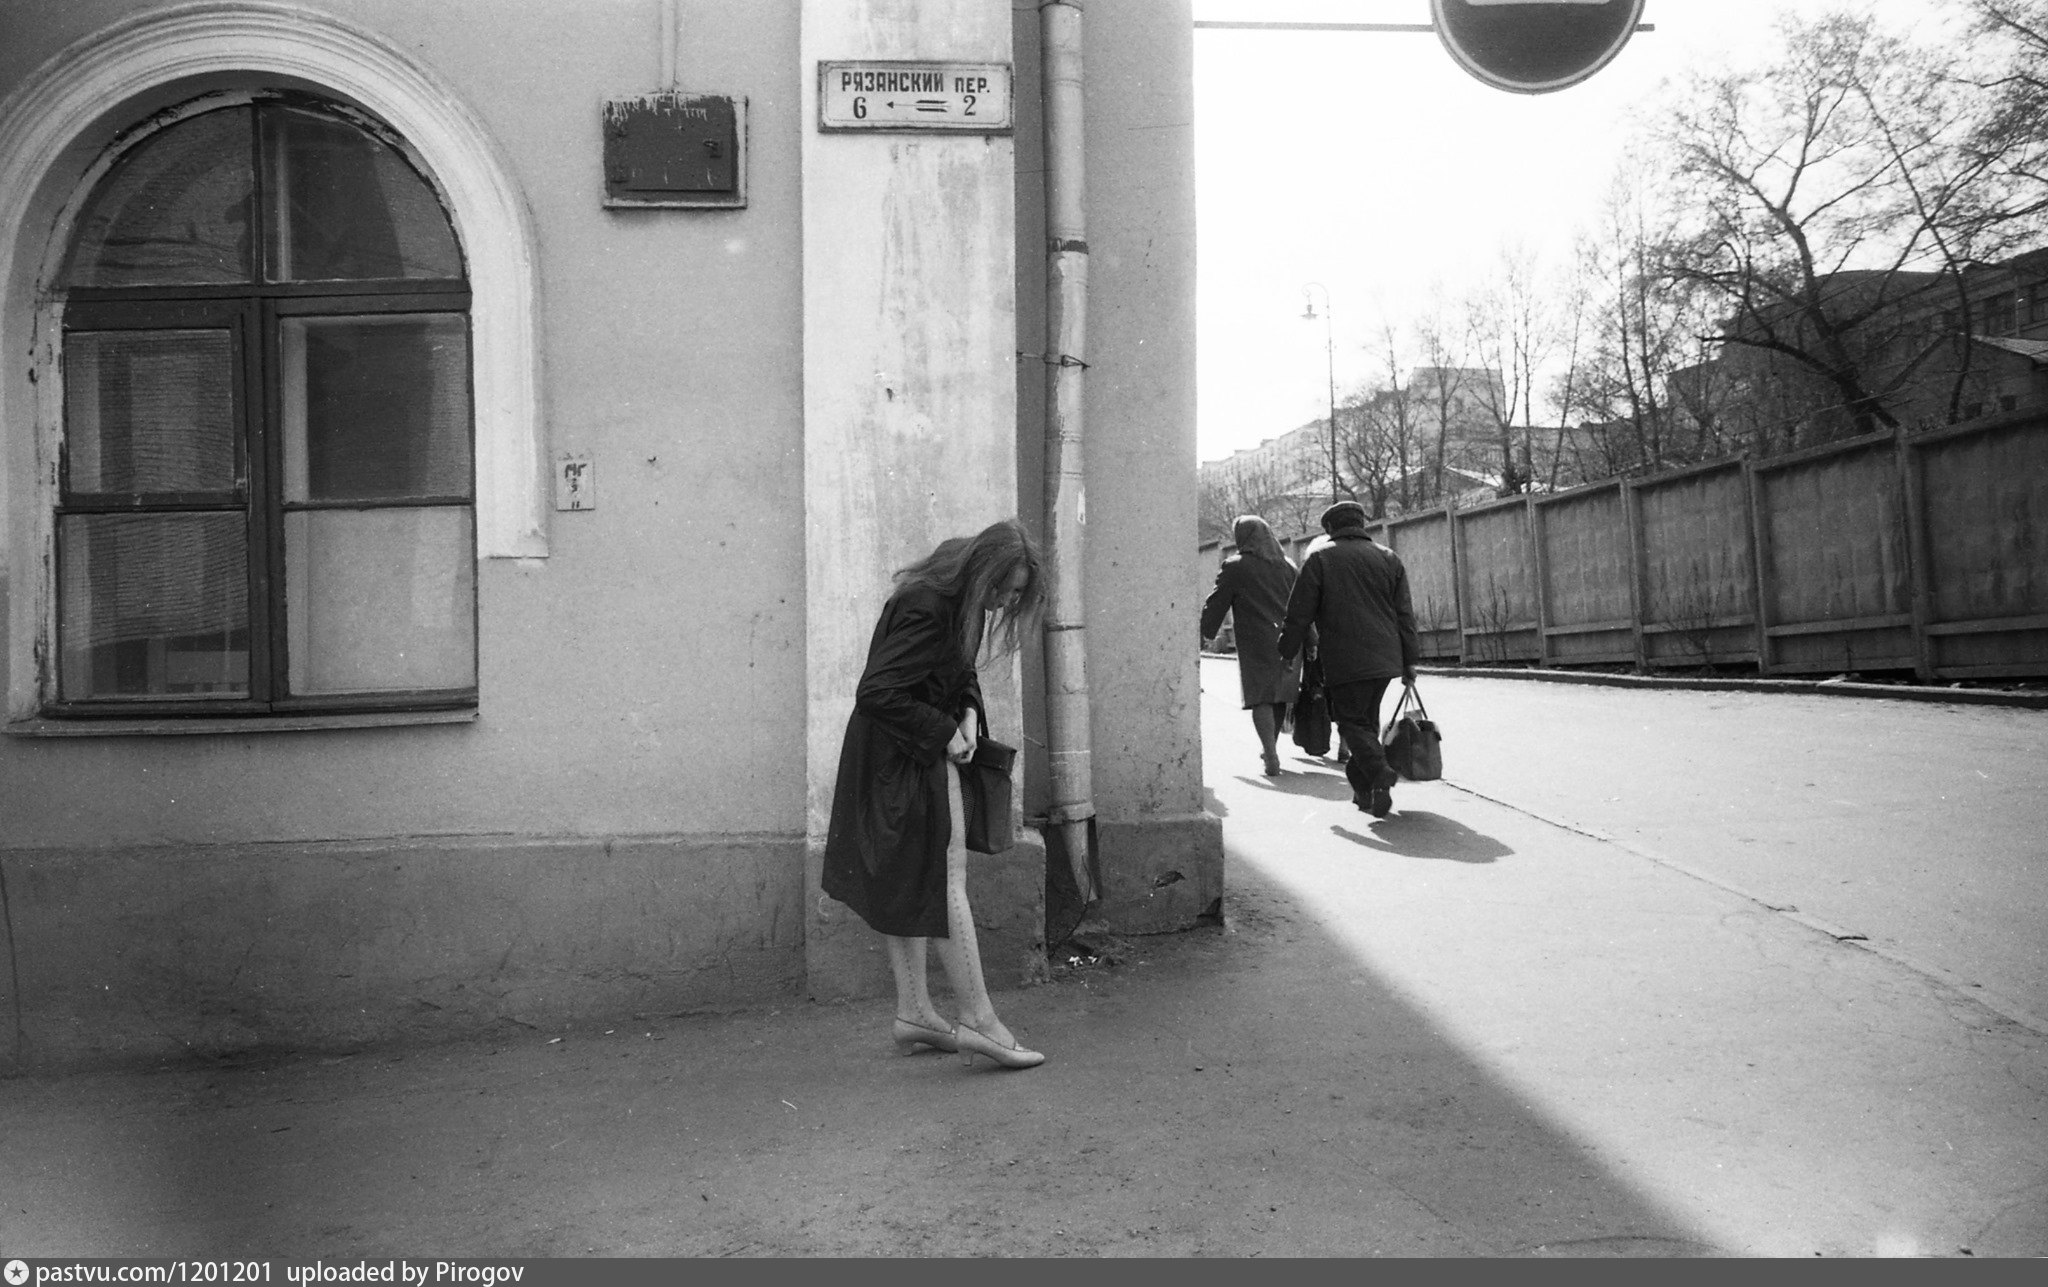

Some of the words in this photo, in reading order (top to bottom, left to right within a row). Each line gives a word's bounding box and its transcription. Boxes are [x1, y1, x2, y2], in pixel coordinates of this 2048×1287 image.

[954, 77, 990, 93] ПЕР.
[853, 96, 867, 119] 6
[963, 94, 976, 116] 2
